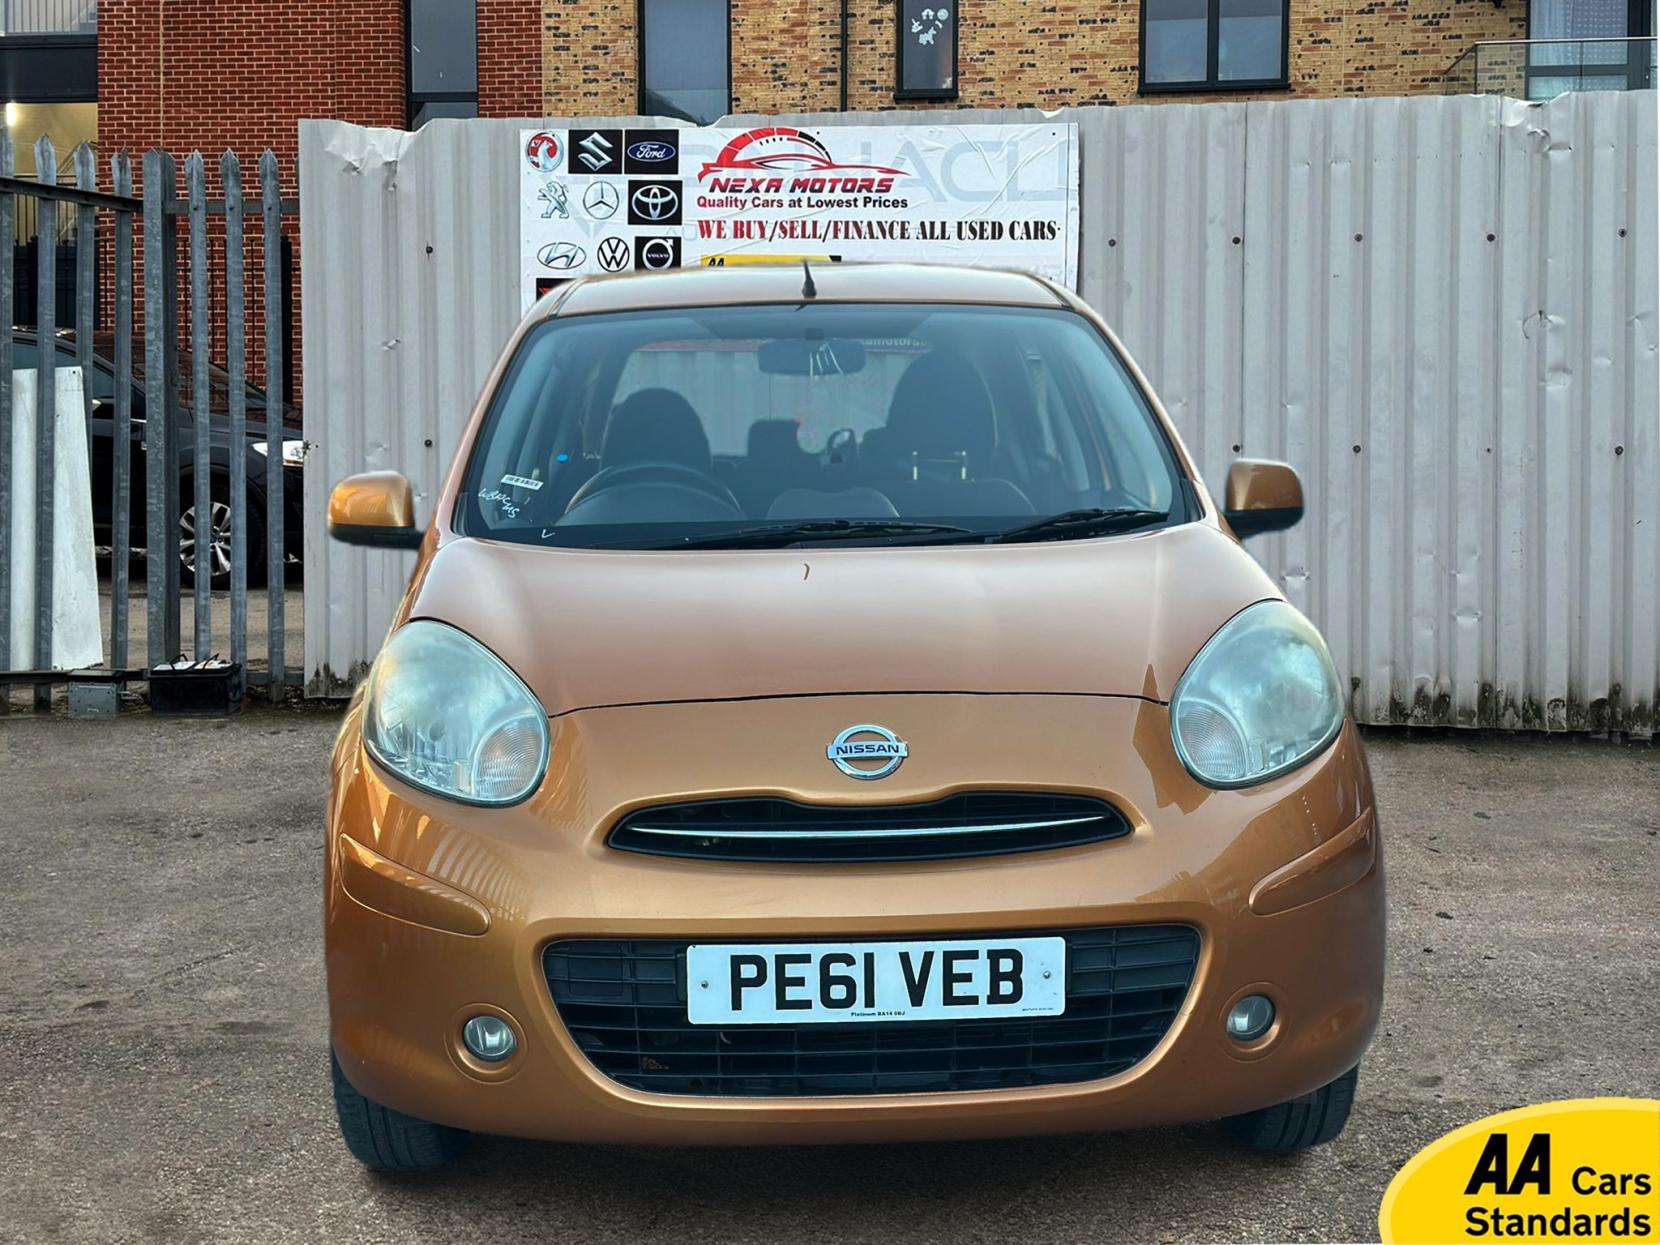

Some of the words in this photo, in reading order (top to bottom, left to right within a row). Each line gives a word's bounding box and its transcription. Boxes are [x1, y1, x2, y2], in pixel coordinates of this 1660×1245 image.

[636, 144, 666, 159] Ford
[708, 177, 784, 194] NEXA
[789, 177, 895, 194] MOTORS
[696, 195, 748, 211] Quality
[752, 195, 784, 209] Cars
[788, 197, 803, 209] at
[807, 195, 859, 209] Lowest
[863, 195, 909, 209] Prices
[697, 219, 727, 240] WE
[732, 219, 911, 243] BUY/SELL/FINANCE
[916, 220, 951, 241] ALL
[956, 220, 1004, 241] USED
[1008, 220, 1057, 241] CARS
[836, 744, 899, 756] NISSAN
[730, 951, 875, 1011] PE61
[898, 948, 1025, 1008] VEB
